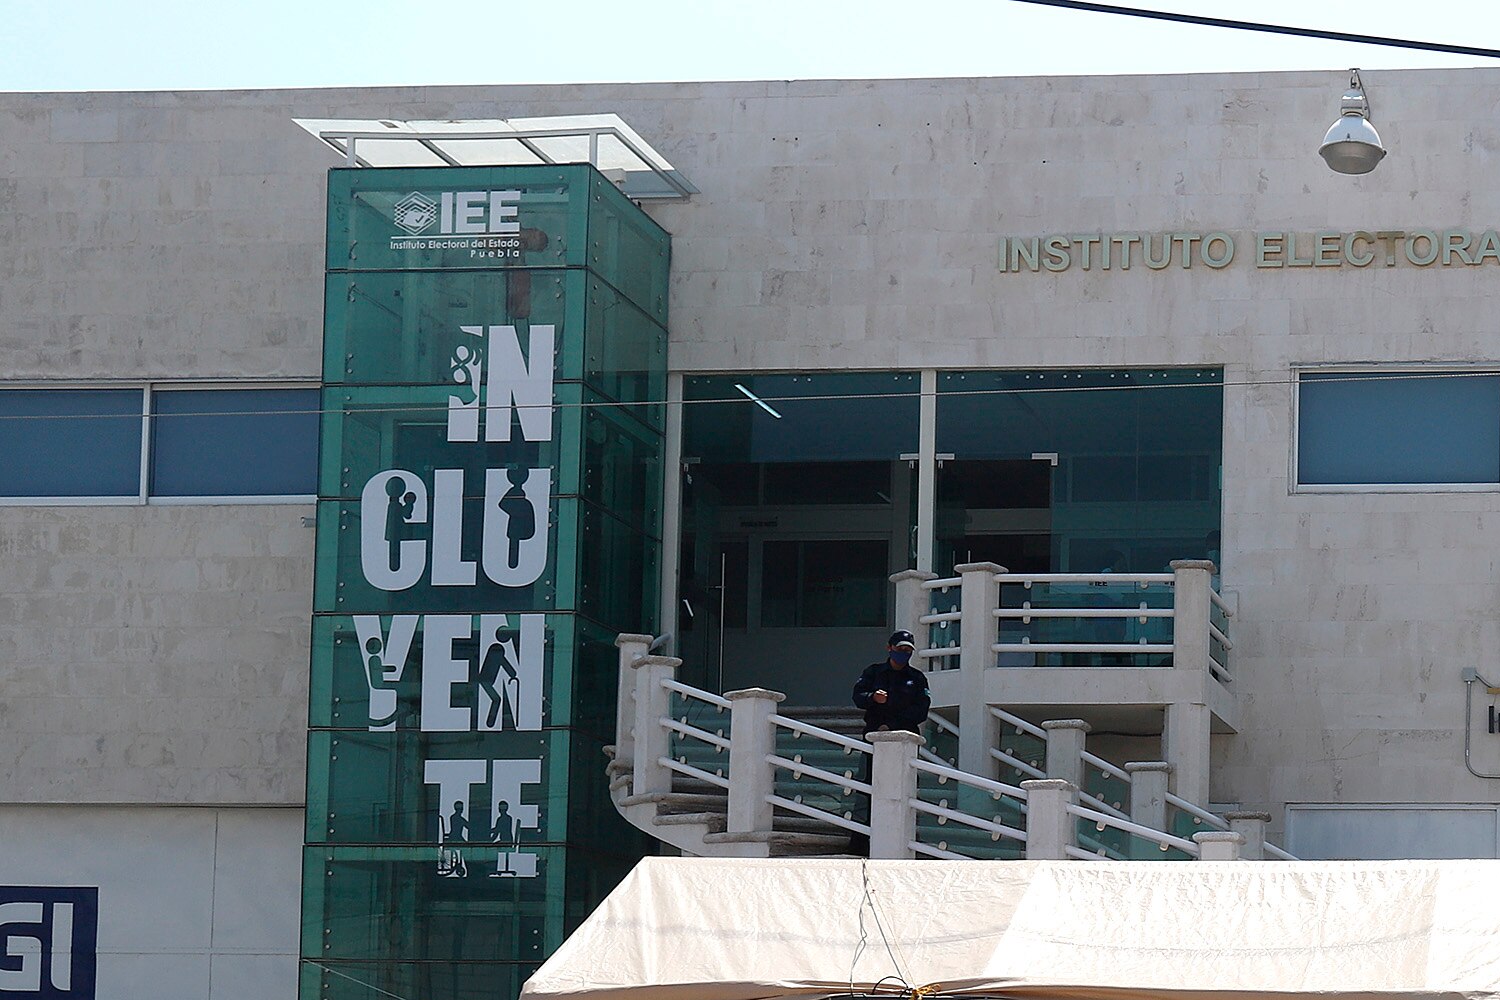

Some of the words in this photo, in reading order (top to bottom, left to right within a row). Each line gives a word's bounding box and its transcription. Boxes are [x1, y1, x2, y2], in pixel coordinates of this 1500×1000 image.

[440, 190, 521, 233] IEE
[390, 239, 426, 250] Instituto
[428, 239, 470, 250] Electoral
[471, 238, 488, 249] del
[489, 238, 520, 249] Estado
[470, 248, 520, 258] Puebla
[998, 231, 1235, 272] INSTITUTO
